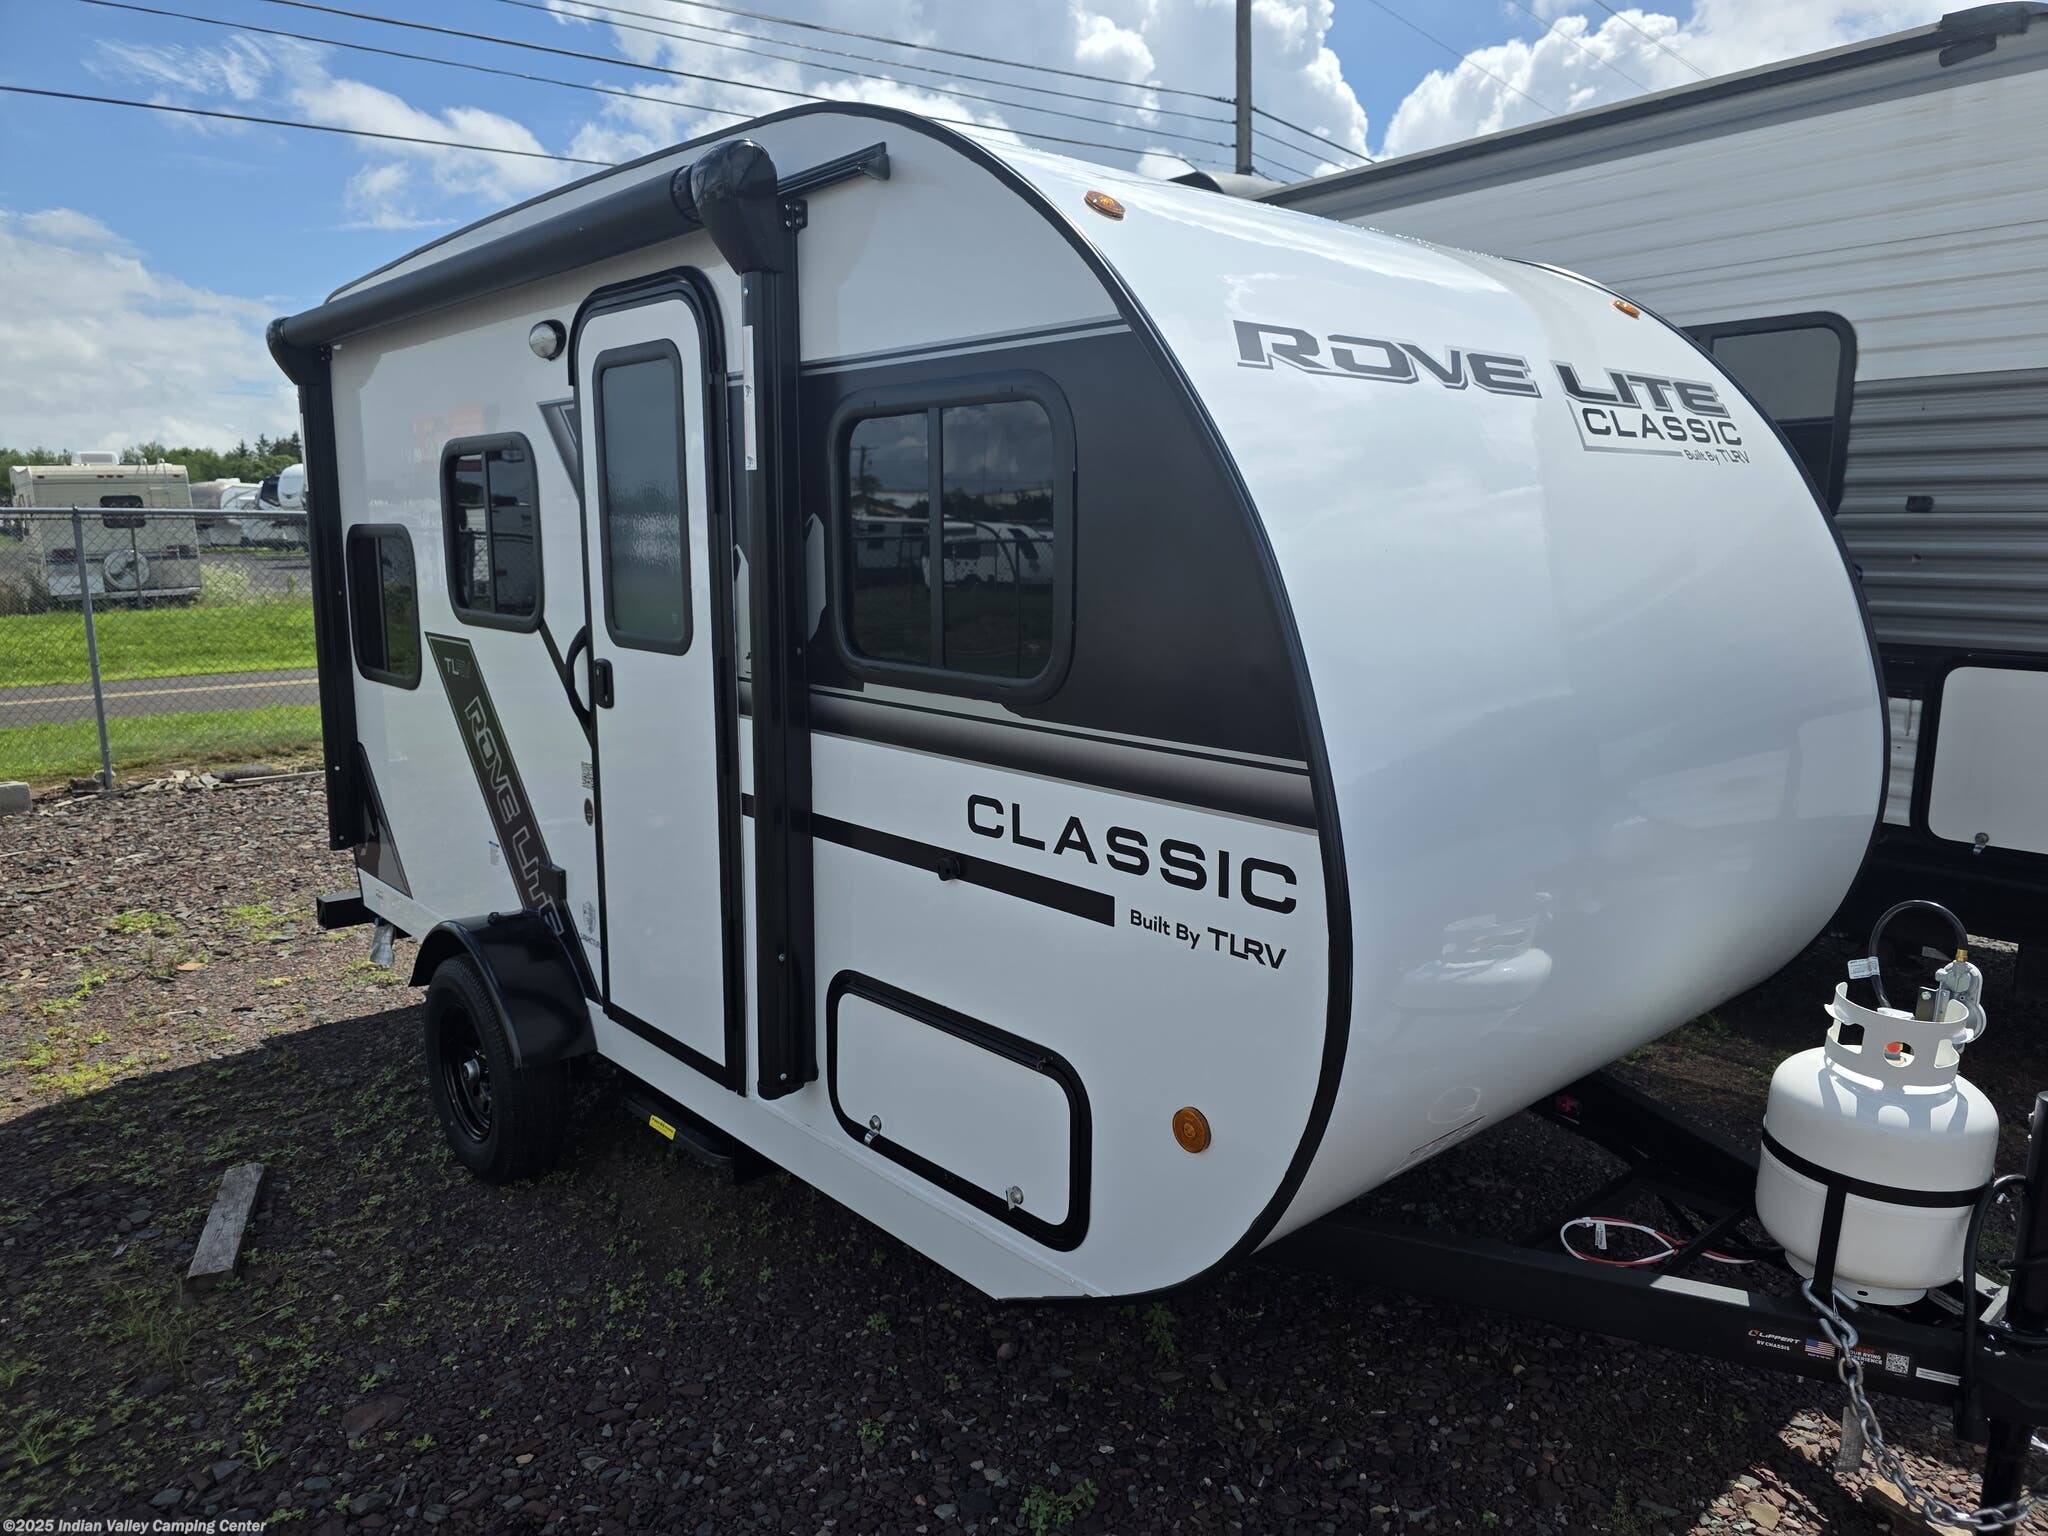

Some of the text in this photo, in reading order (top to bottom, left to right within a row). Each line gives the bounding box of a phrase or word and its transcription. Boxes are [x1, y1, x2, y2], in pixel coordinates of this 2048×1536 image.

[1232, 319, 1731, 419] ROVE LITE
[1581, 407, 1743, 447] CLASSIC
[1683, 448, 1751, 466] Built By TLRV
[464, 696, 521, 825] ROVE
[967, 793, 1298, 915] CLASSIC
[1129, 908, 1288, 970] Built By TLRV
[1756, 1339, 1791, 1351] RV CHASSIS
[1759, 1331, 1801, 1345] LIPPERT
[1851, 1354, 1883, 1365] PERIENCE
